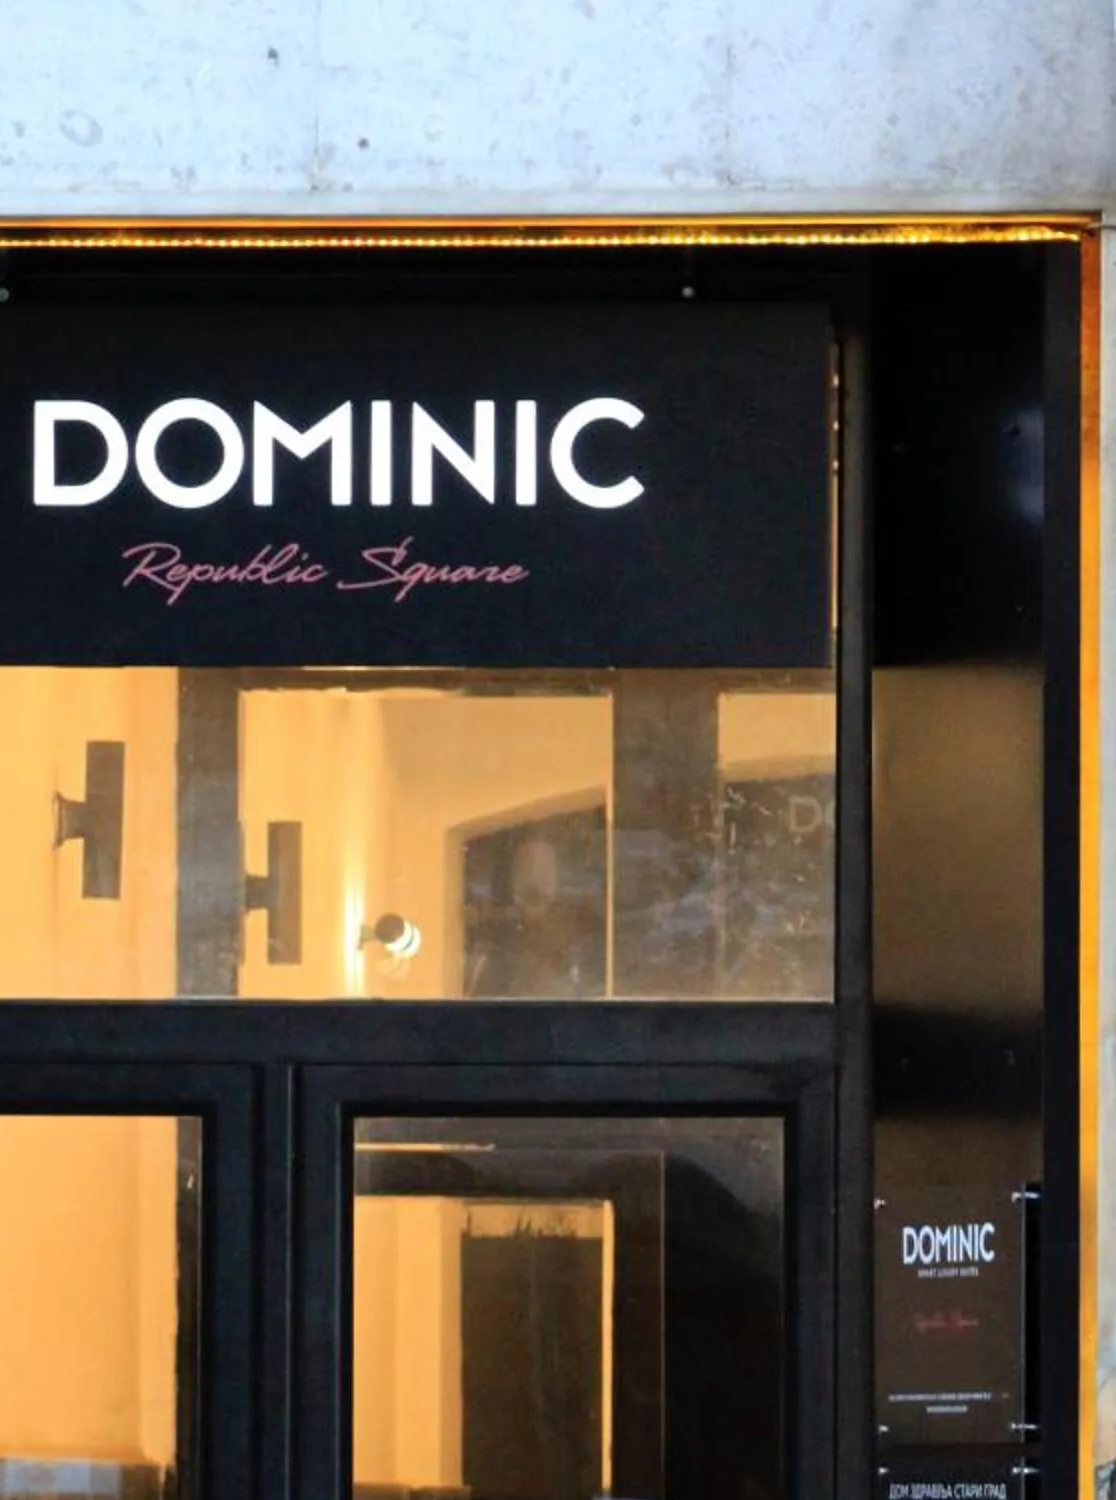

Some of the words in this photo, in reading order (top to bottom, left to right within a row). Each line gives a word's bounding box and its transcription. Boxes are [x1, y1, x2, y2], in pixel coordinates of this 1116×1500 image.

[34, 397, 645, 509] DOMINIC
[121, 541, 328, 606] Republic
[336, 536, 530, 603] Square
[902, 1222, 996, 1265] DOMINIC
